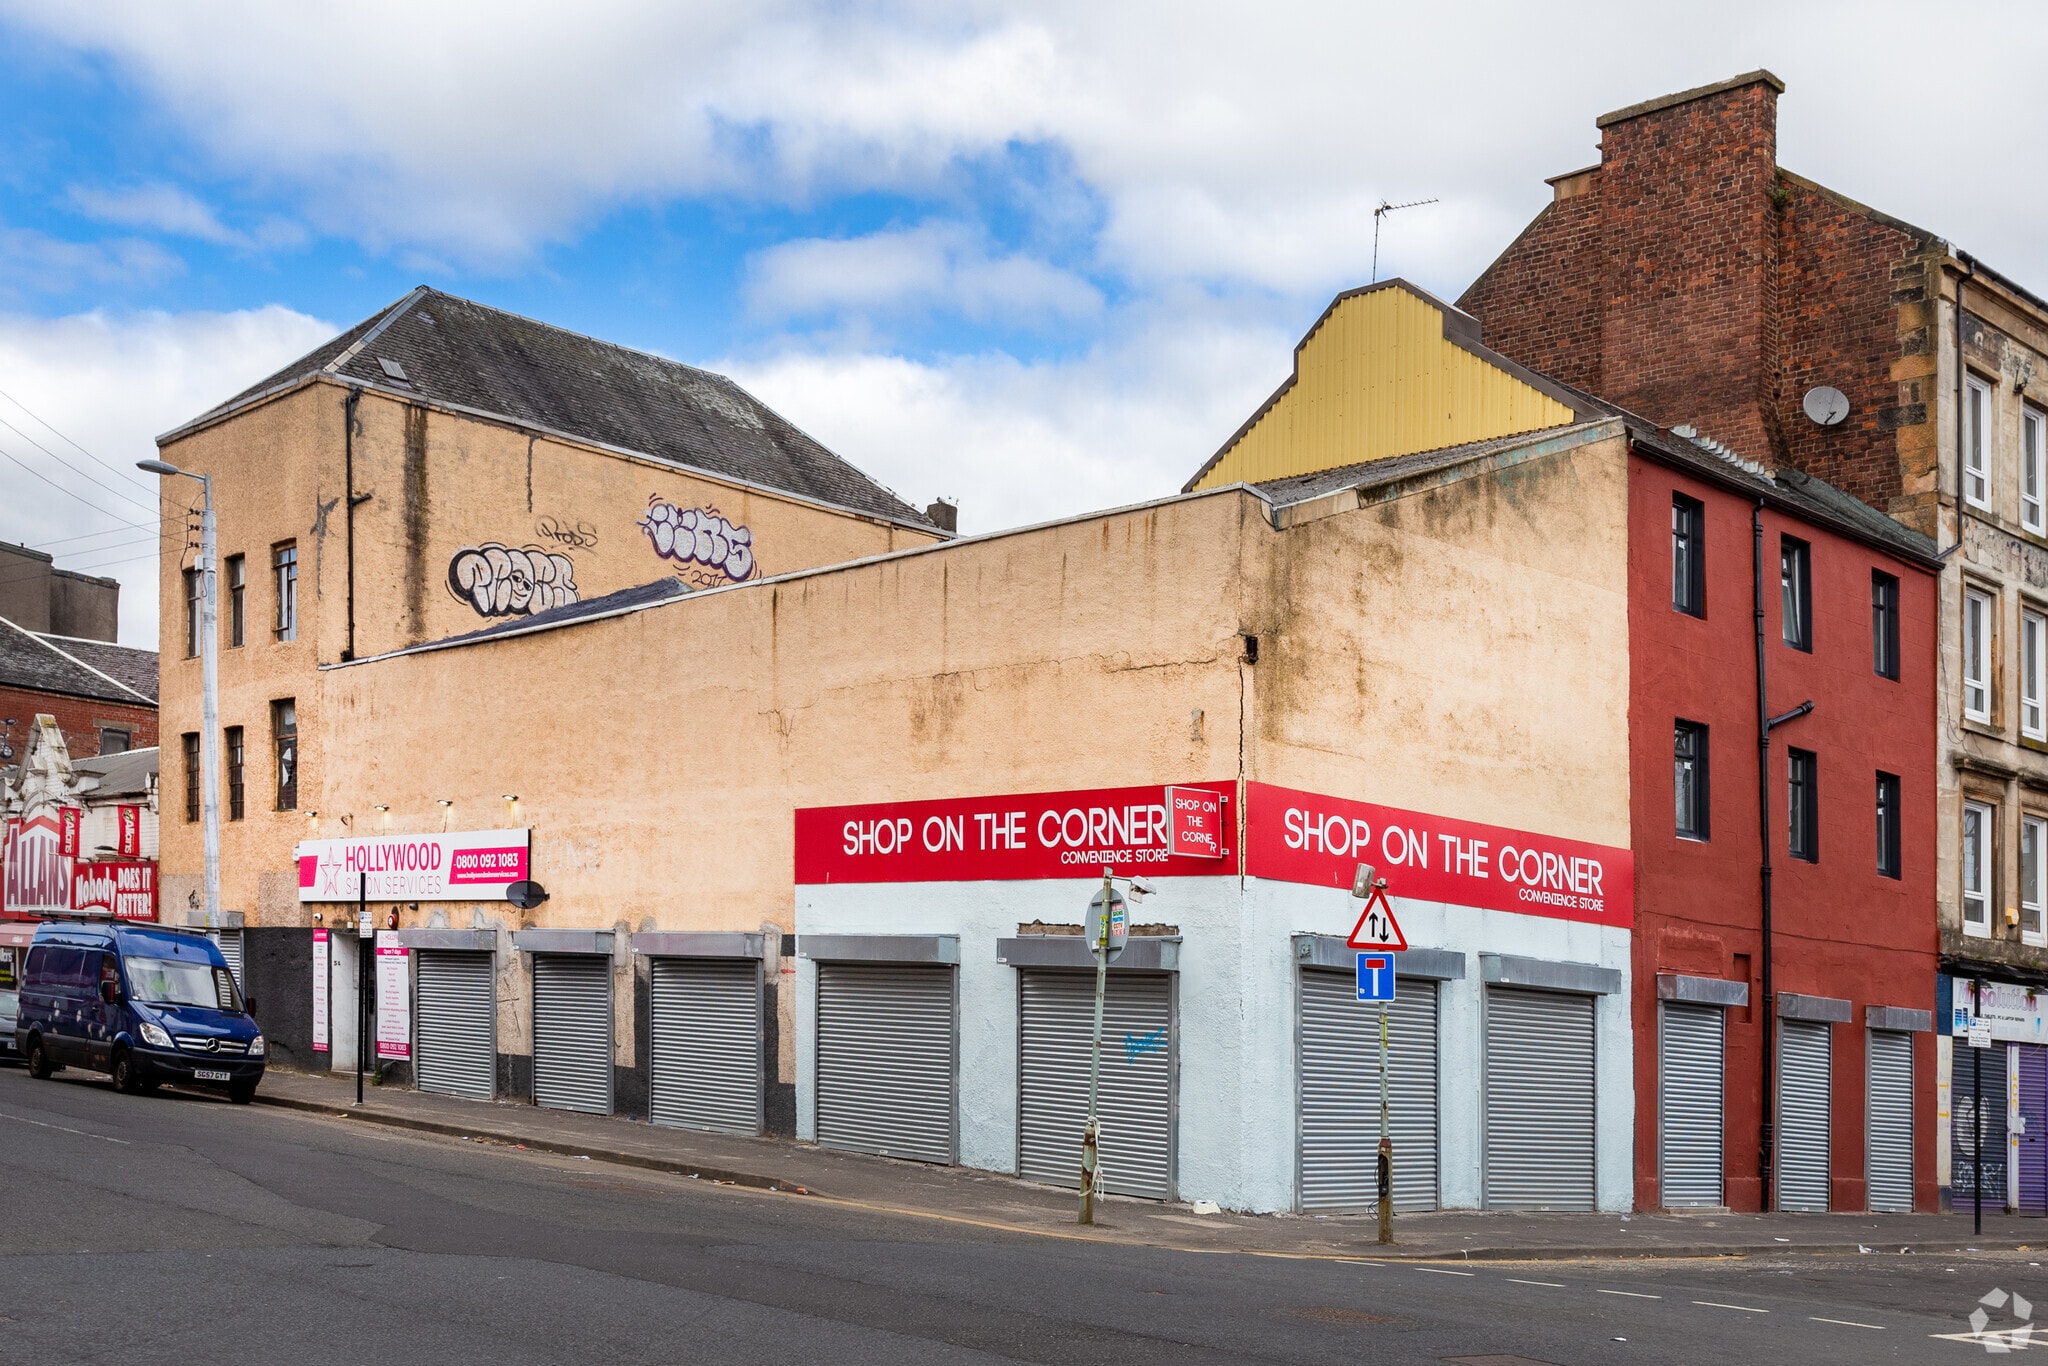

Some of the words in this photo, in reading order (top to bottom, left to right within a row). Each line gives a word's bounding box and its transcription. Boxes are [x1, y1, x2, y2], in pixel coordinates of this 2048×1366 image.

[1175, 798, 1200, 811] SHOP
[1202, 801, 1217, 813] ON
[842, 819, 913, 857] SHOP
[922, 815, 964, 853] ON
[974, 812, 1027, 851] THE
[1037, 804, 1168, 849] CORNER
[1186, 815, 1203, 828] THE
[1181, 830, 1217, 853] CORNER
[1283, 807, 1371, 858] SHOP
[1382, 825, 1428, 869] ON
[1438, 834, 1489, 879] THE
[1498, 845, 1604, 897] CORNER
[6, 827, 69, 908] ALLANS
[345, 842, 442, 872] HOLLYWOOD
[456, 854, 478, 869] 0800
[480, 853, 496, 868] 092
[497, 852, 519, 867] 1083
[1061, 849, 1133, 864] CONVENIENCE
[1135, 848, 1169, 863] STORE
[76, 866, 117, 911] Nobody
[118, 867, 141, 891] DOES
[142, 867, 151, 891] IT
[345, 876, 380, 895] SAON
[385, 875, 442, 895] SERVICES
[117, 892, 152, 917] BETTER!
[1518, 888, 1578, 909] CONVENIENCE
[1578, 897, 1604, 912] STORE
